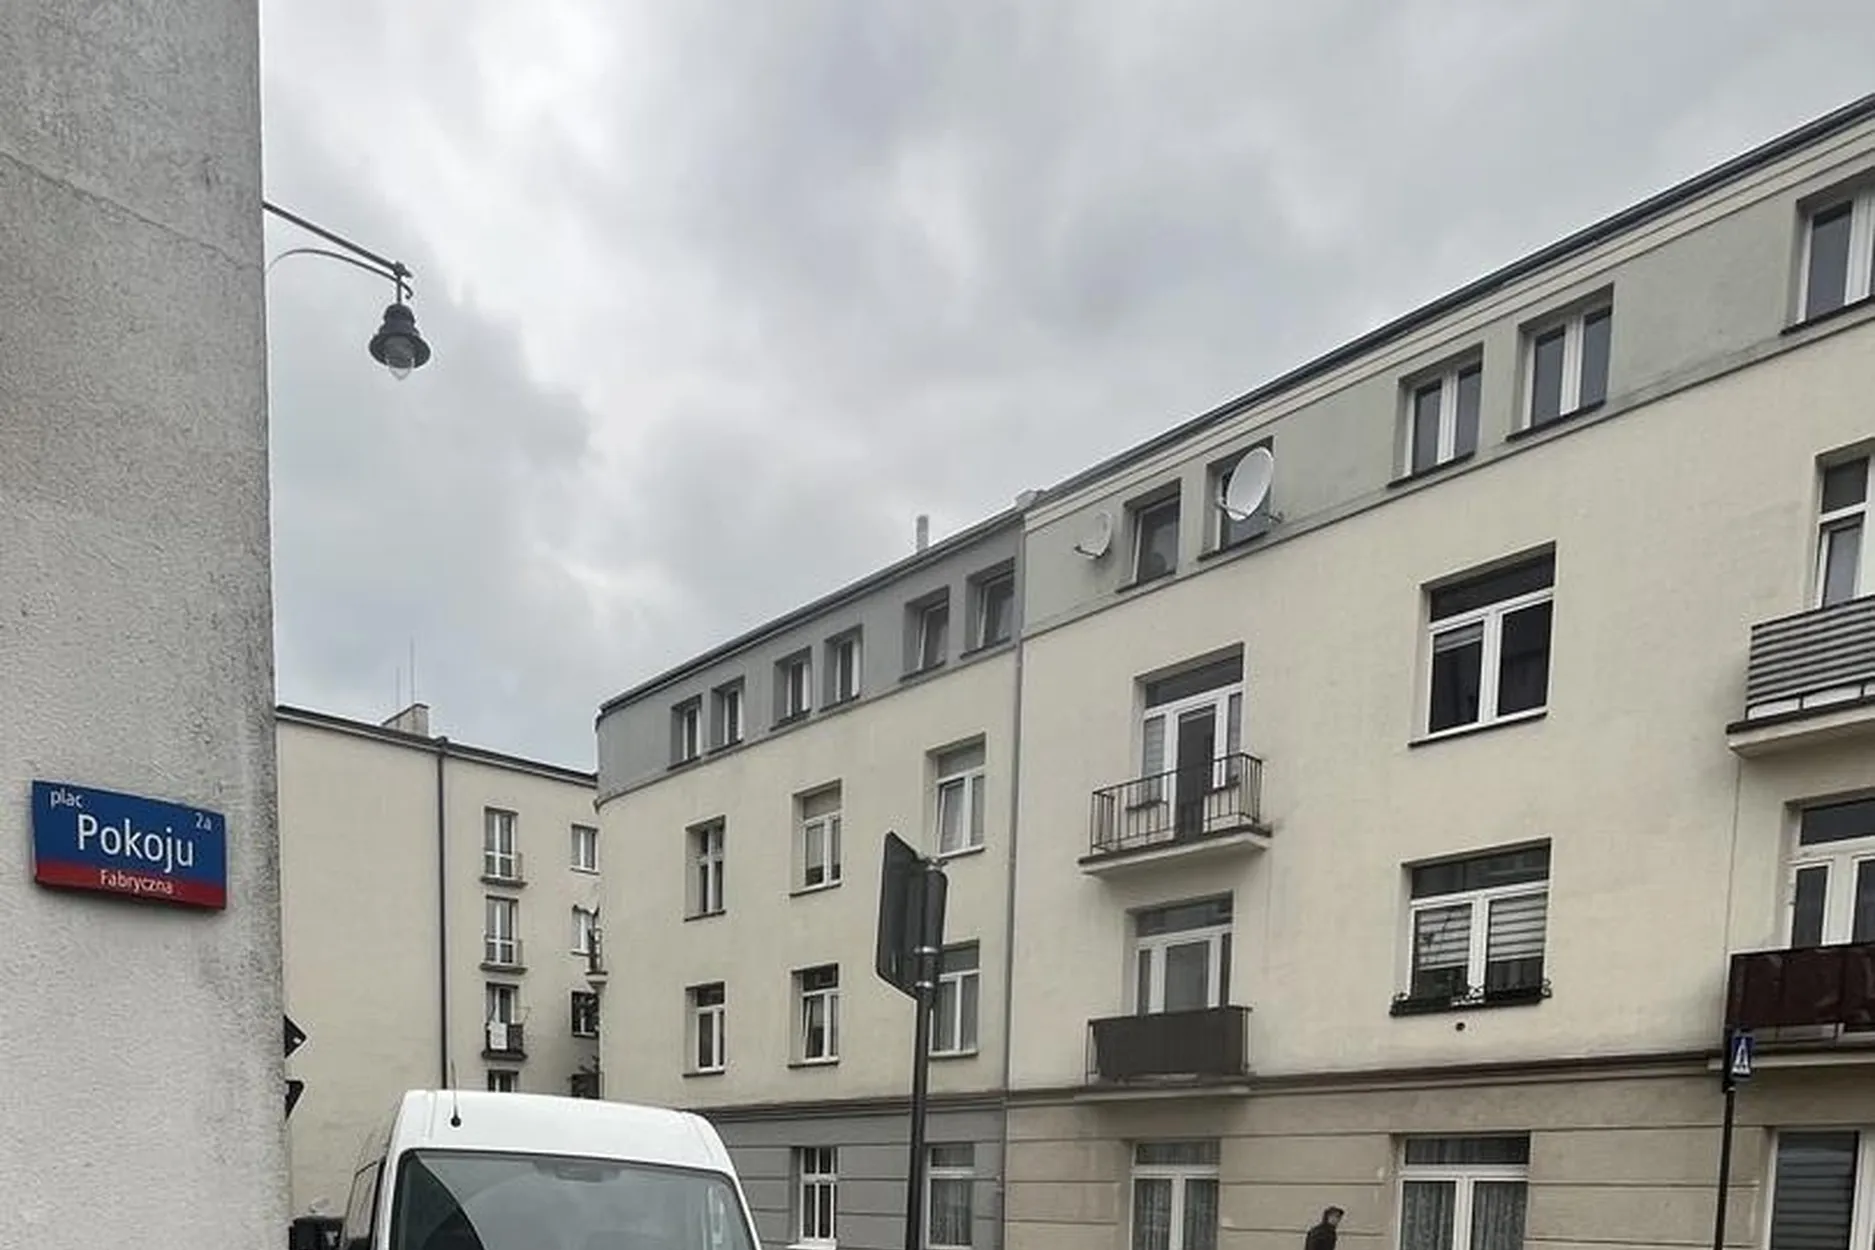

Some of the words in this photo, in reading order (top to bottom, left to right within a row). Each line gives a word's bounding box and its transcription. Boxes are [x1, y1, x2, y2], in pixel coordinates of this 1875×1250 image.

[50, 788, 83, 809] plac
[195, 811, 211, 831] 2a
[78, 814, 193, 873] Pokoju
[100, 869, 173, 894] Fabryczna
